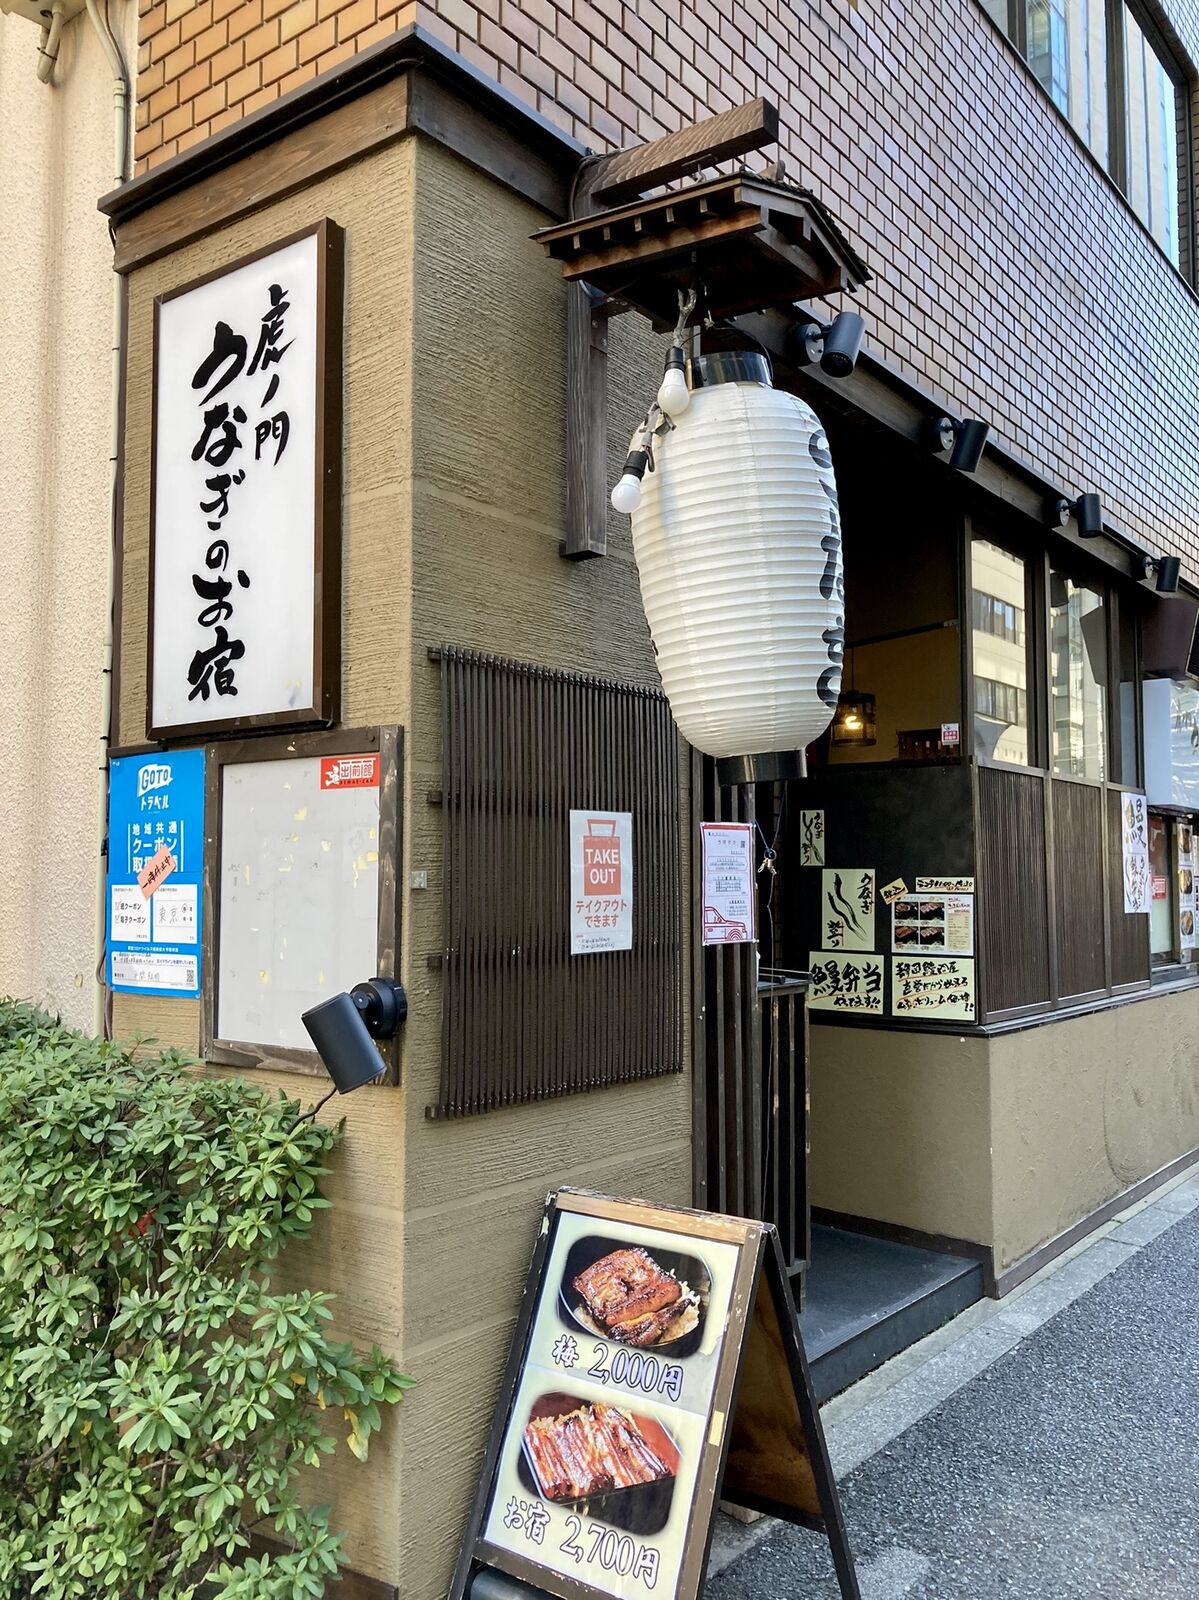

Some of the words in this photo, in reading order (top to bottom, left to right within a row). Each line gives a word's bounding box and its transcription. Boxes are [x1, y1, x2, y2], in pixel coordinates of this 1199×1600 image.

[247, 283, 297, 466] 虎ノ門
[188, 320, 250, 701] うなぎのお宿
[340, 763, 372, 778] 出前館
[140, 794, 169, 811] トラベル
[132, 820, 177, 836] 地域共通
[132, 836, 178, 854] クーポン
[585, 849, 619, 865] TAKE
[590, 868, 616, 885] OUT
[857, 873, 875, 915] うなぎ
[575, 899, 628, 914] テイクアウト
[583, 914, 619, 928] できます
[810, 960, 881, 996] 鰻弁当
[552, 1334, 580, 1369] 梅
[587, 1342, 684, 1402] 2,000円
[503, 1495, 550, 1545] お宿
[560, 1514, 661, 1590] 2,700円
